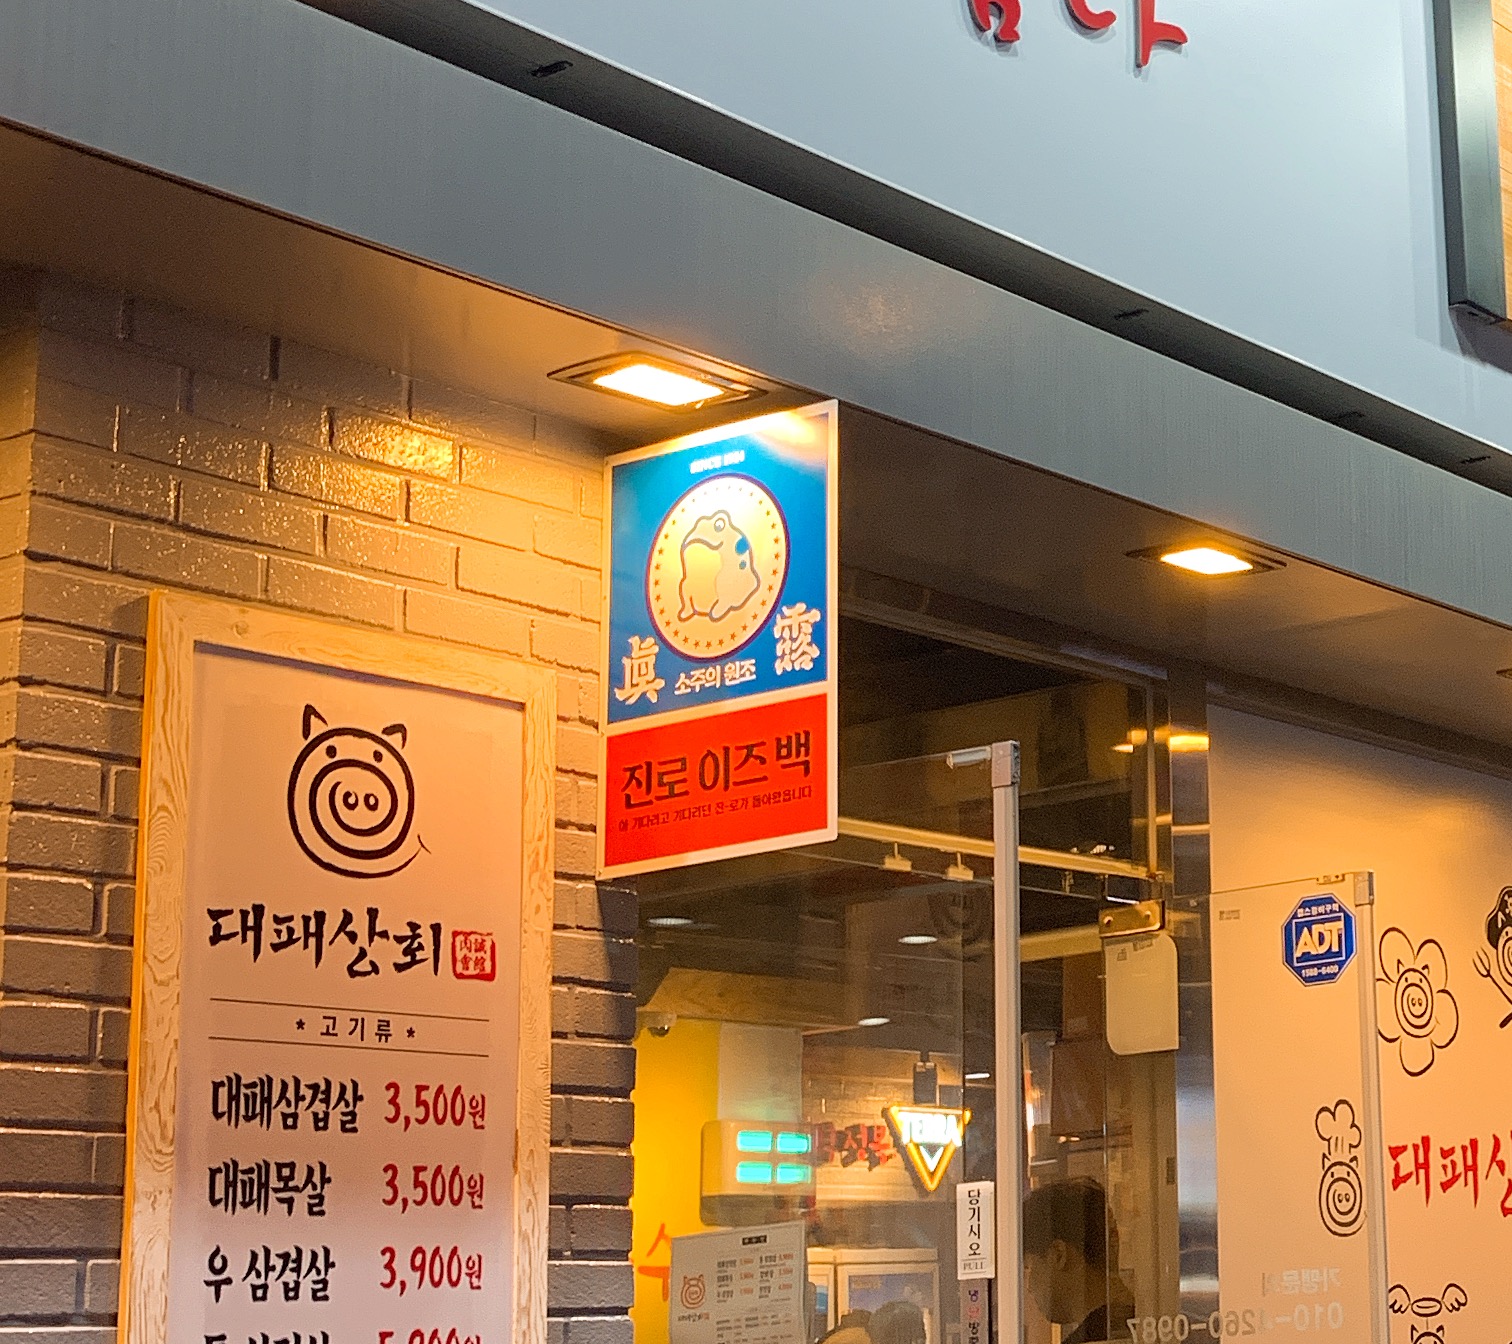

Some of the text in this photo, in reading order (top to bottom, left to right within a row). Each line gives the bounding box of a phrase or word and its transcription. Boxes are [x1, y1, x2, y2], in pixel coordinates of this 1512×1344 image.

[674, 659, 757, 696] 소주의 원조
[620, 729, 812, 810] 진로 이즈 백
[207, 904, 441, 978] 대패상회
[1296, 922, 1343, 956] ADT
[321, 1016, 391, 1042] 고기류
[212, 1073, 486, 1133] 대패삼겹살 3,500원
[209, 1158, 484, 1216] 대패목살 3,500원
[968, 1188, 981, 1256] 당기시오
[204, 1246, 482, 1303] 우 삼겹살 3,900원
